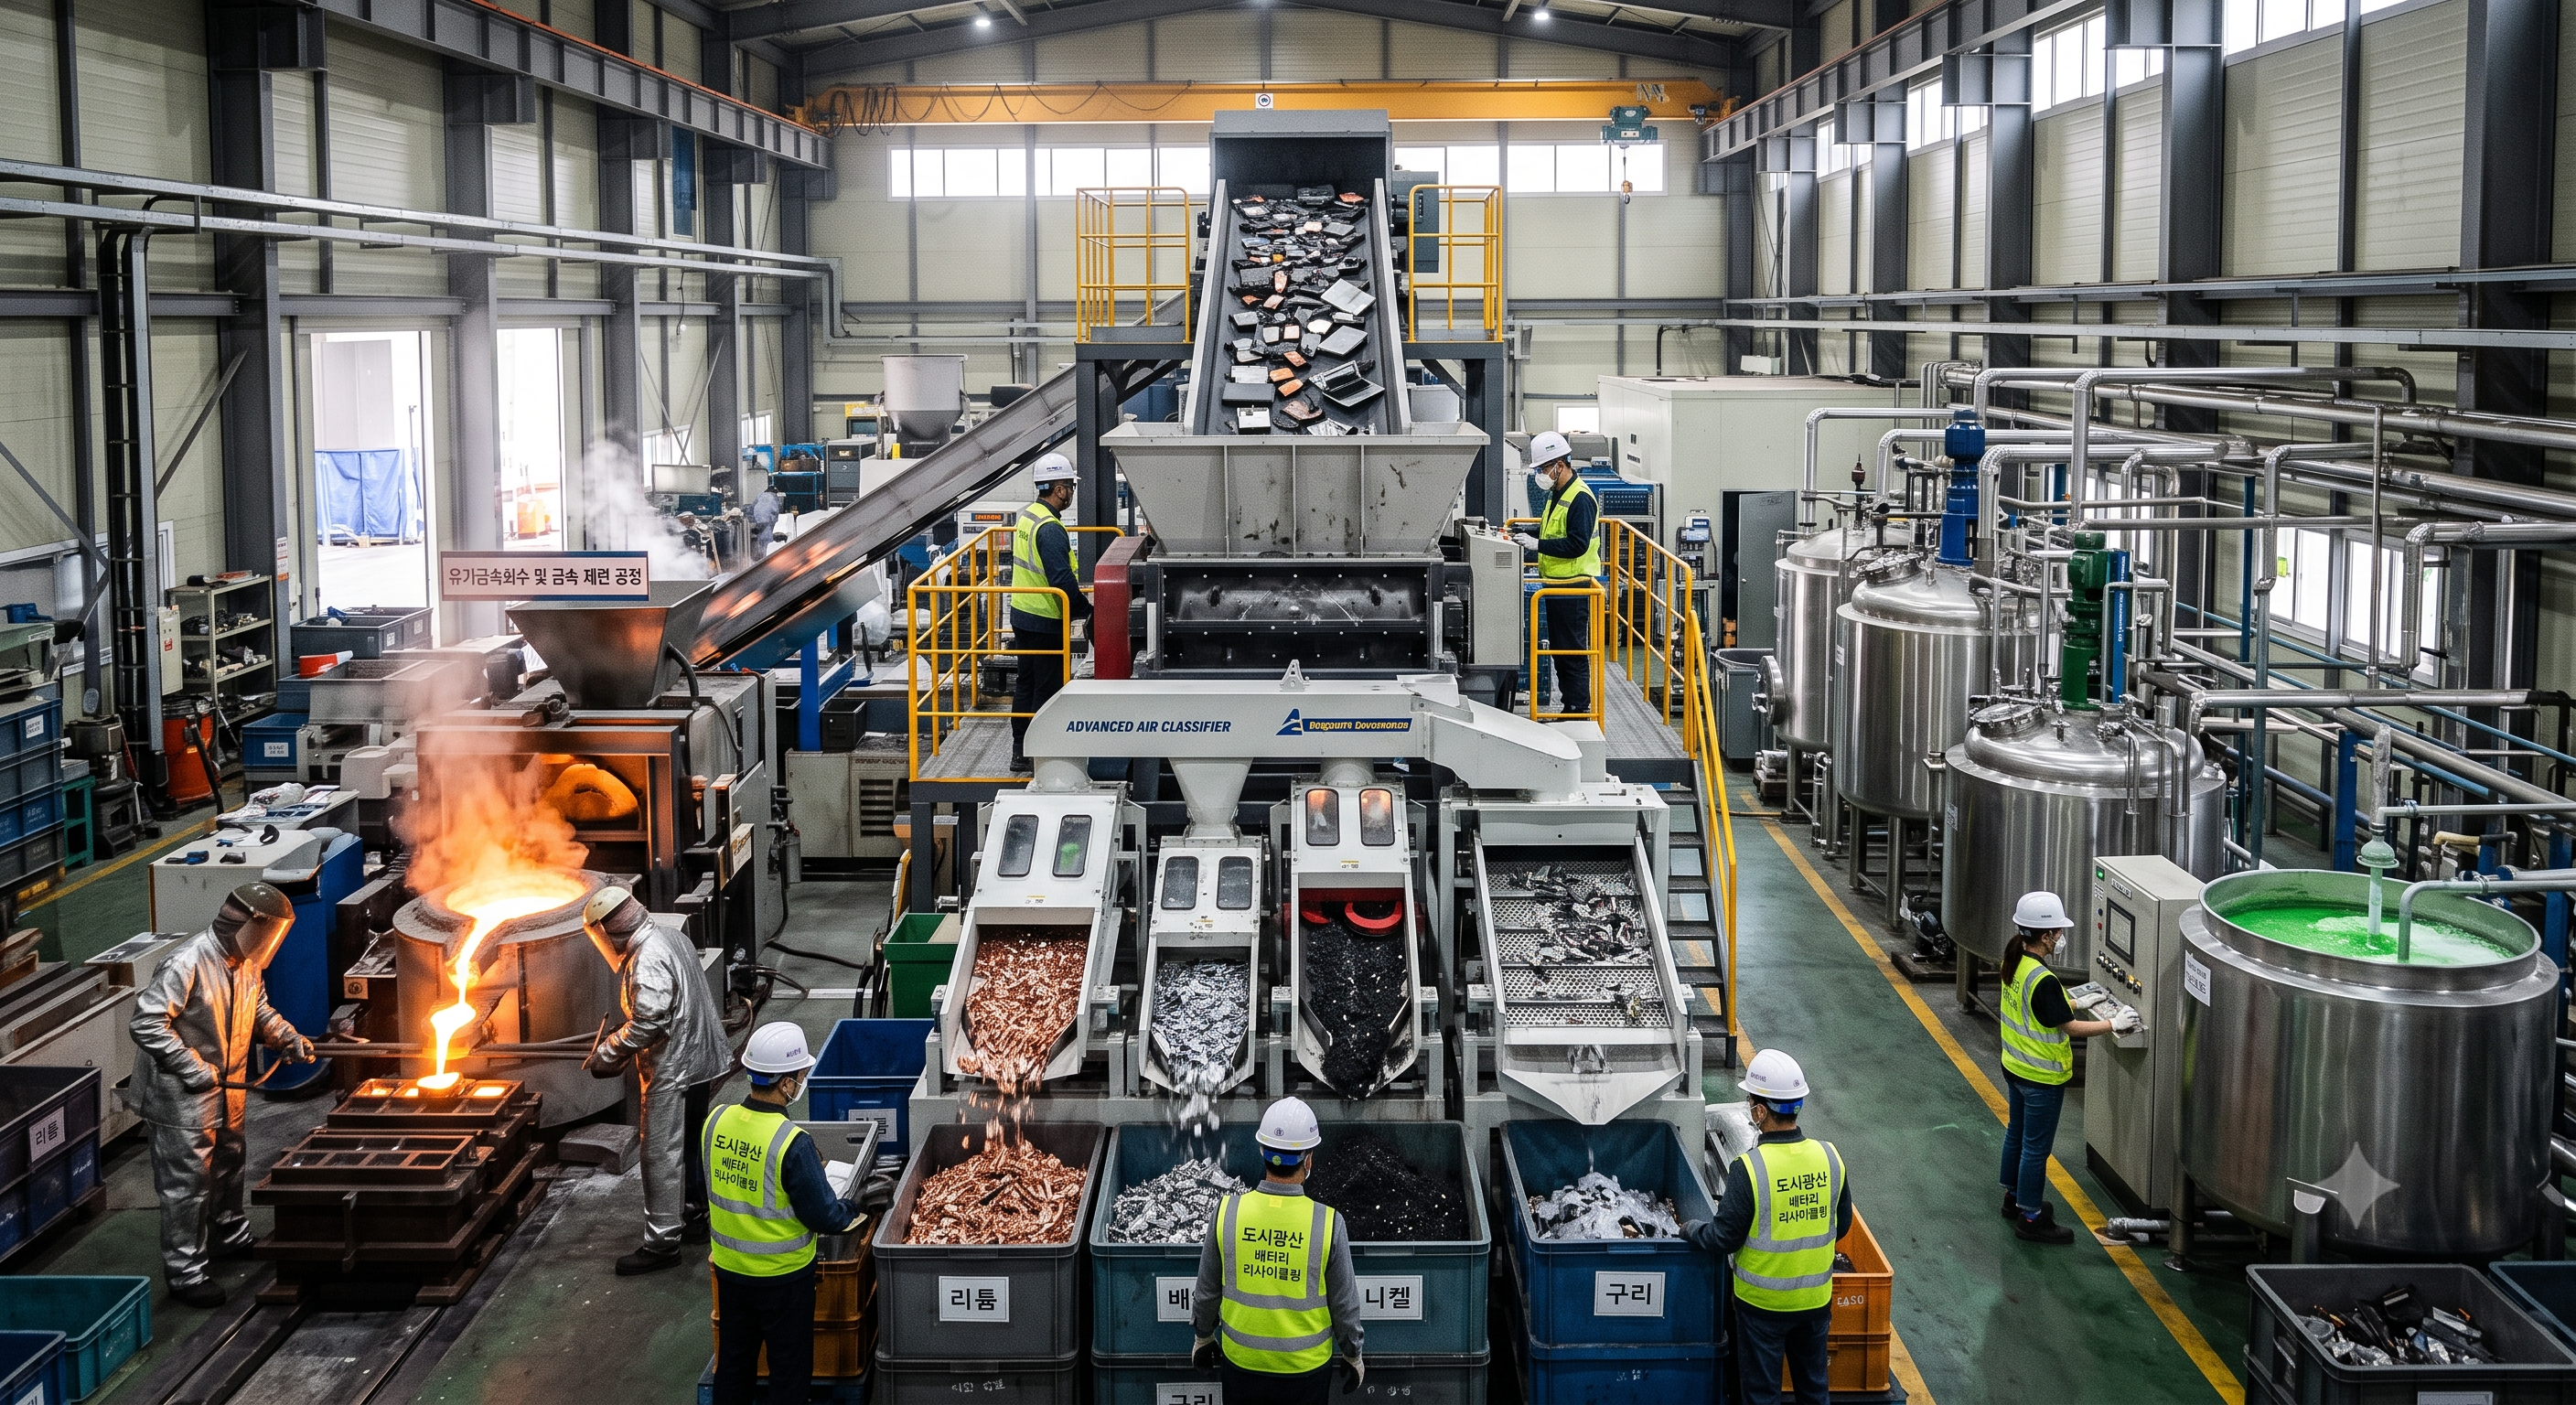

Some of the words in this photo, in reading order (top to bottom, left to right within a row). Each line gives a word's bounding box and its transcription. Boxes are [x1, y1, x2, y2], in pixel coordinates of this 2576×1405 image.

[534, 567, 547, 586] 및
[552, 568, 579, 586] 금속
[584, 567, 610, 586] 제련
[615, 568, 642, 586] 공정
[1066, 721, 1134, 733] ADVANCED
[1136, 721, 1159, 733] AIR
[1161, 721, 1231, 733] CLASSIFIER
[1776, 1171, 1828, 1193] 도시광산
[1241, 1227, 1304, 1249] 도시광산
[1254, 1249, 1290, 1266] 배터리
[1243, 1263, 1302, 1282] 리사이클링
[950, 1288, 997, 1311] 리튬
[1168, 1288, 1196, 1311] 배
[1366, 1286, 1411, 1309] 니켈
[1605, 1282, 1652, 1305] 구리
